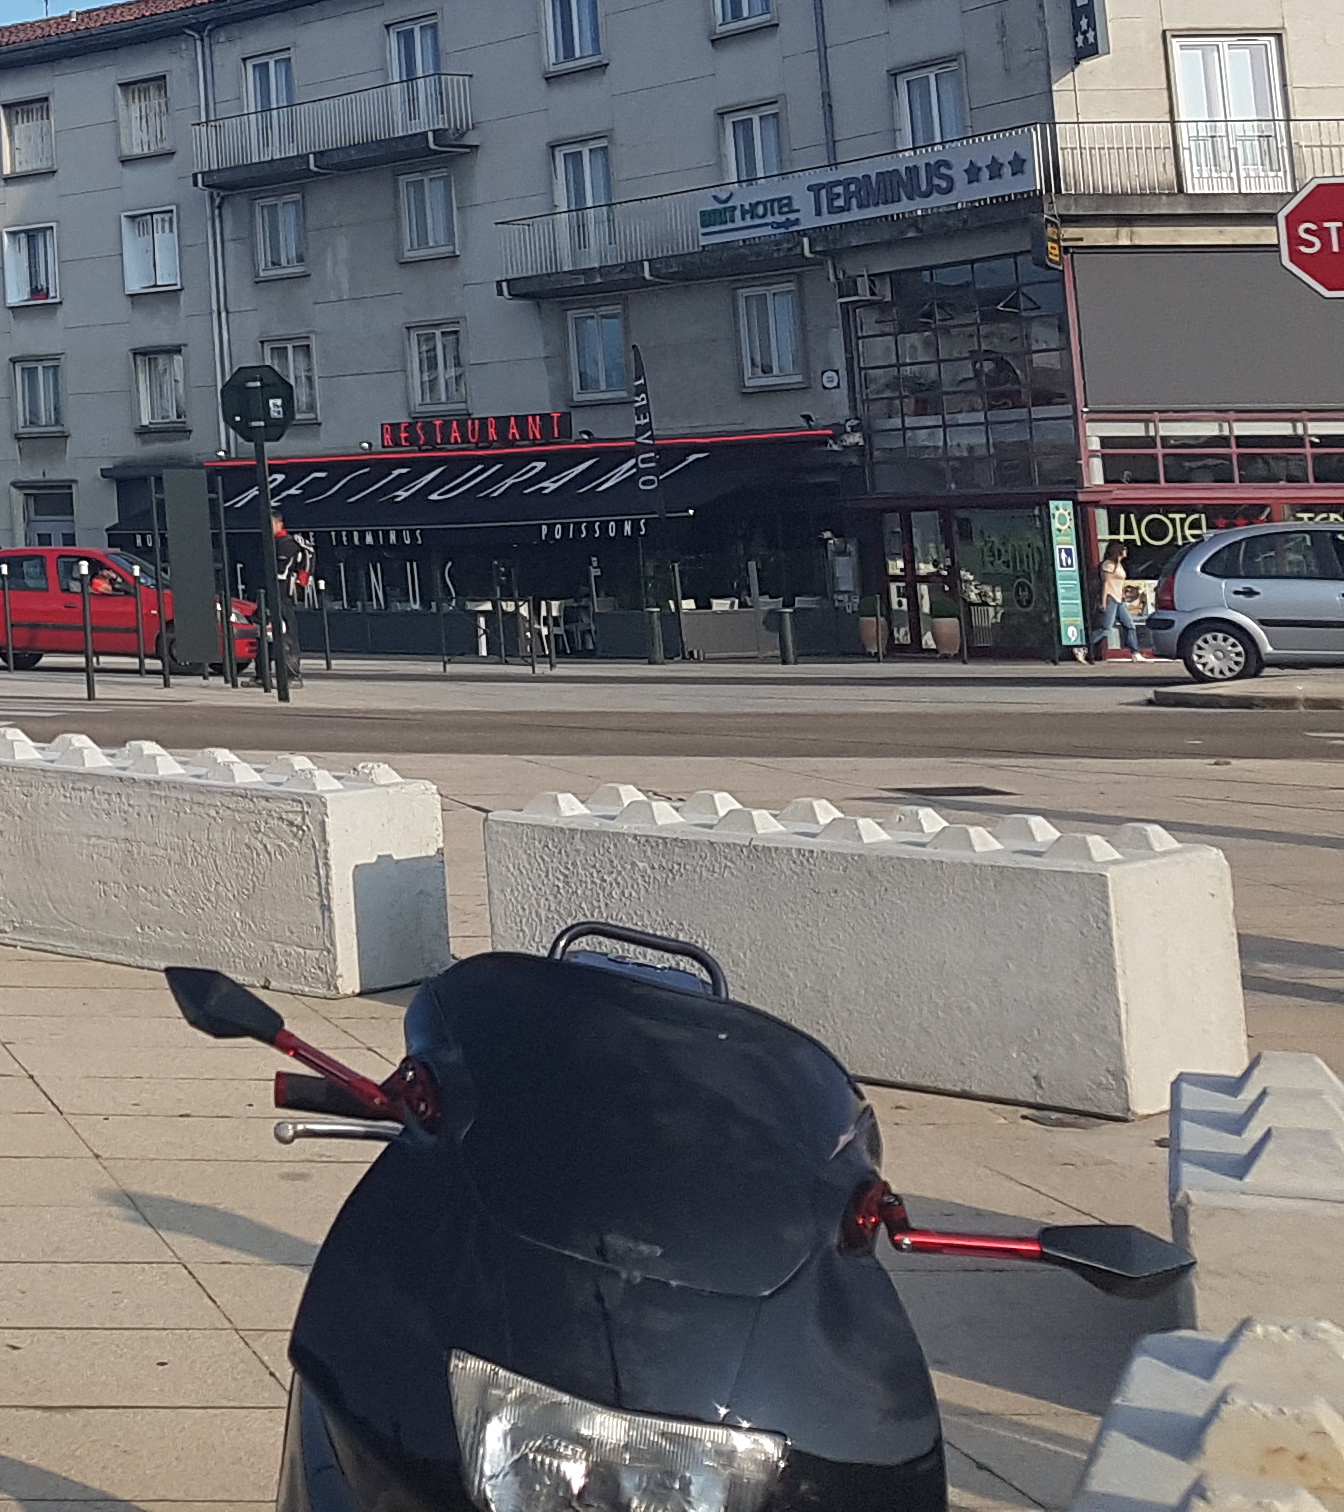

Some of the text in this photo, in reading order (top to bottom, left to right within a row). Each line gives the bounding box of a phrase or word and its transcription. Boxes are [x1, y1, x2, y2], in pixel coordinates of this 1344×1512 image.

[699, 159, 955, 228] BRIT HOTEL TERMINUS
[383, 412, 561, 446] RESTAURANT
[633, 375, 659, 490] OUVERT
[224, 453, 710, 508] RESTAURANT
[331, 529, 422, 545] TERMINUS
[541, 518, 647, 539] POISSONS
